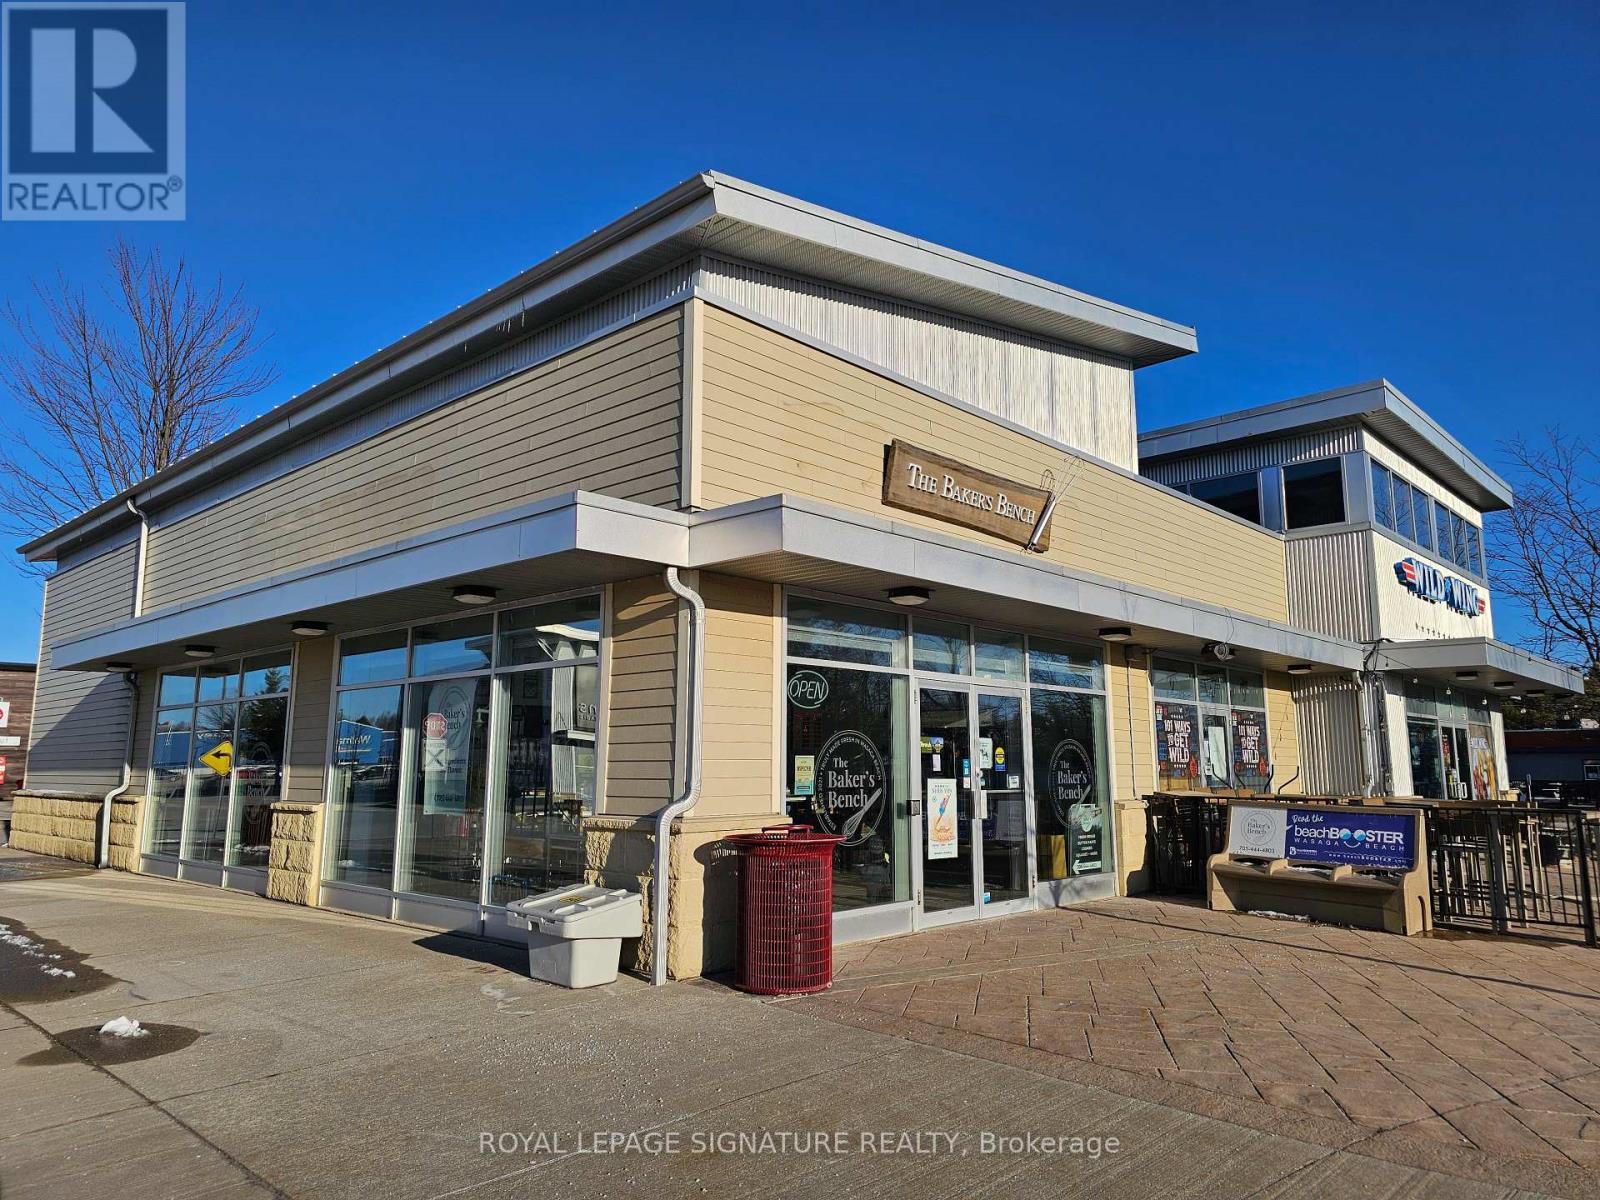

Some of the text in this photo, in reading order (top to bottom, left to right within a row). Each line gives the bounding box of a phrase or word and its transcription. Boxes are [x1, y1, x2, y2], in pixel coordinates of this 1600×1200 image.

[907, 463, 938, 494] THE
[995, 493, 1036, 524] BENCH
[1411, 559, 1446, 601] WILD
[790, 680, 825, 699] OPEN
[1164, 720, 1191, 733] 101 WAYS
[1238, 724, 1260, 737] 101 WAYS
[1174, 733, 1190, 748] GET
[1247, 737, 1259, 750] GET
[833, 757, 849, 768] The
[1168, 747, 1190, 763] WILD
[1242, 749, 1260, 764] WILD
[1060, 761, 1070, 769] The
[828, 770, 875, 788] Baker's
[1057, 770, 1088, 784] Baker's
[828, 789, 868, 809] Bench
[1058, 785, 1083, 800] Bench
[1312, 814, 1324, 823] the
[1294, 825, 1404, 844] beachBOOSTER
[1294, 838, 1405, 852] WASAGA BEACH
